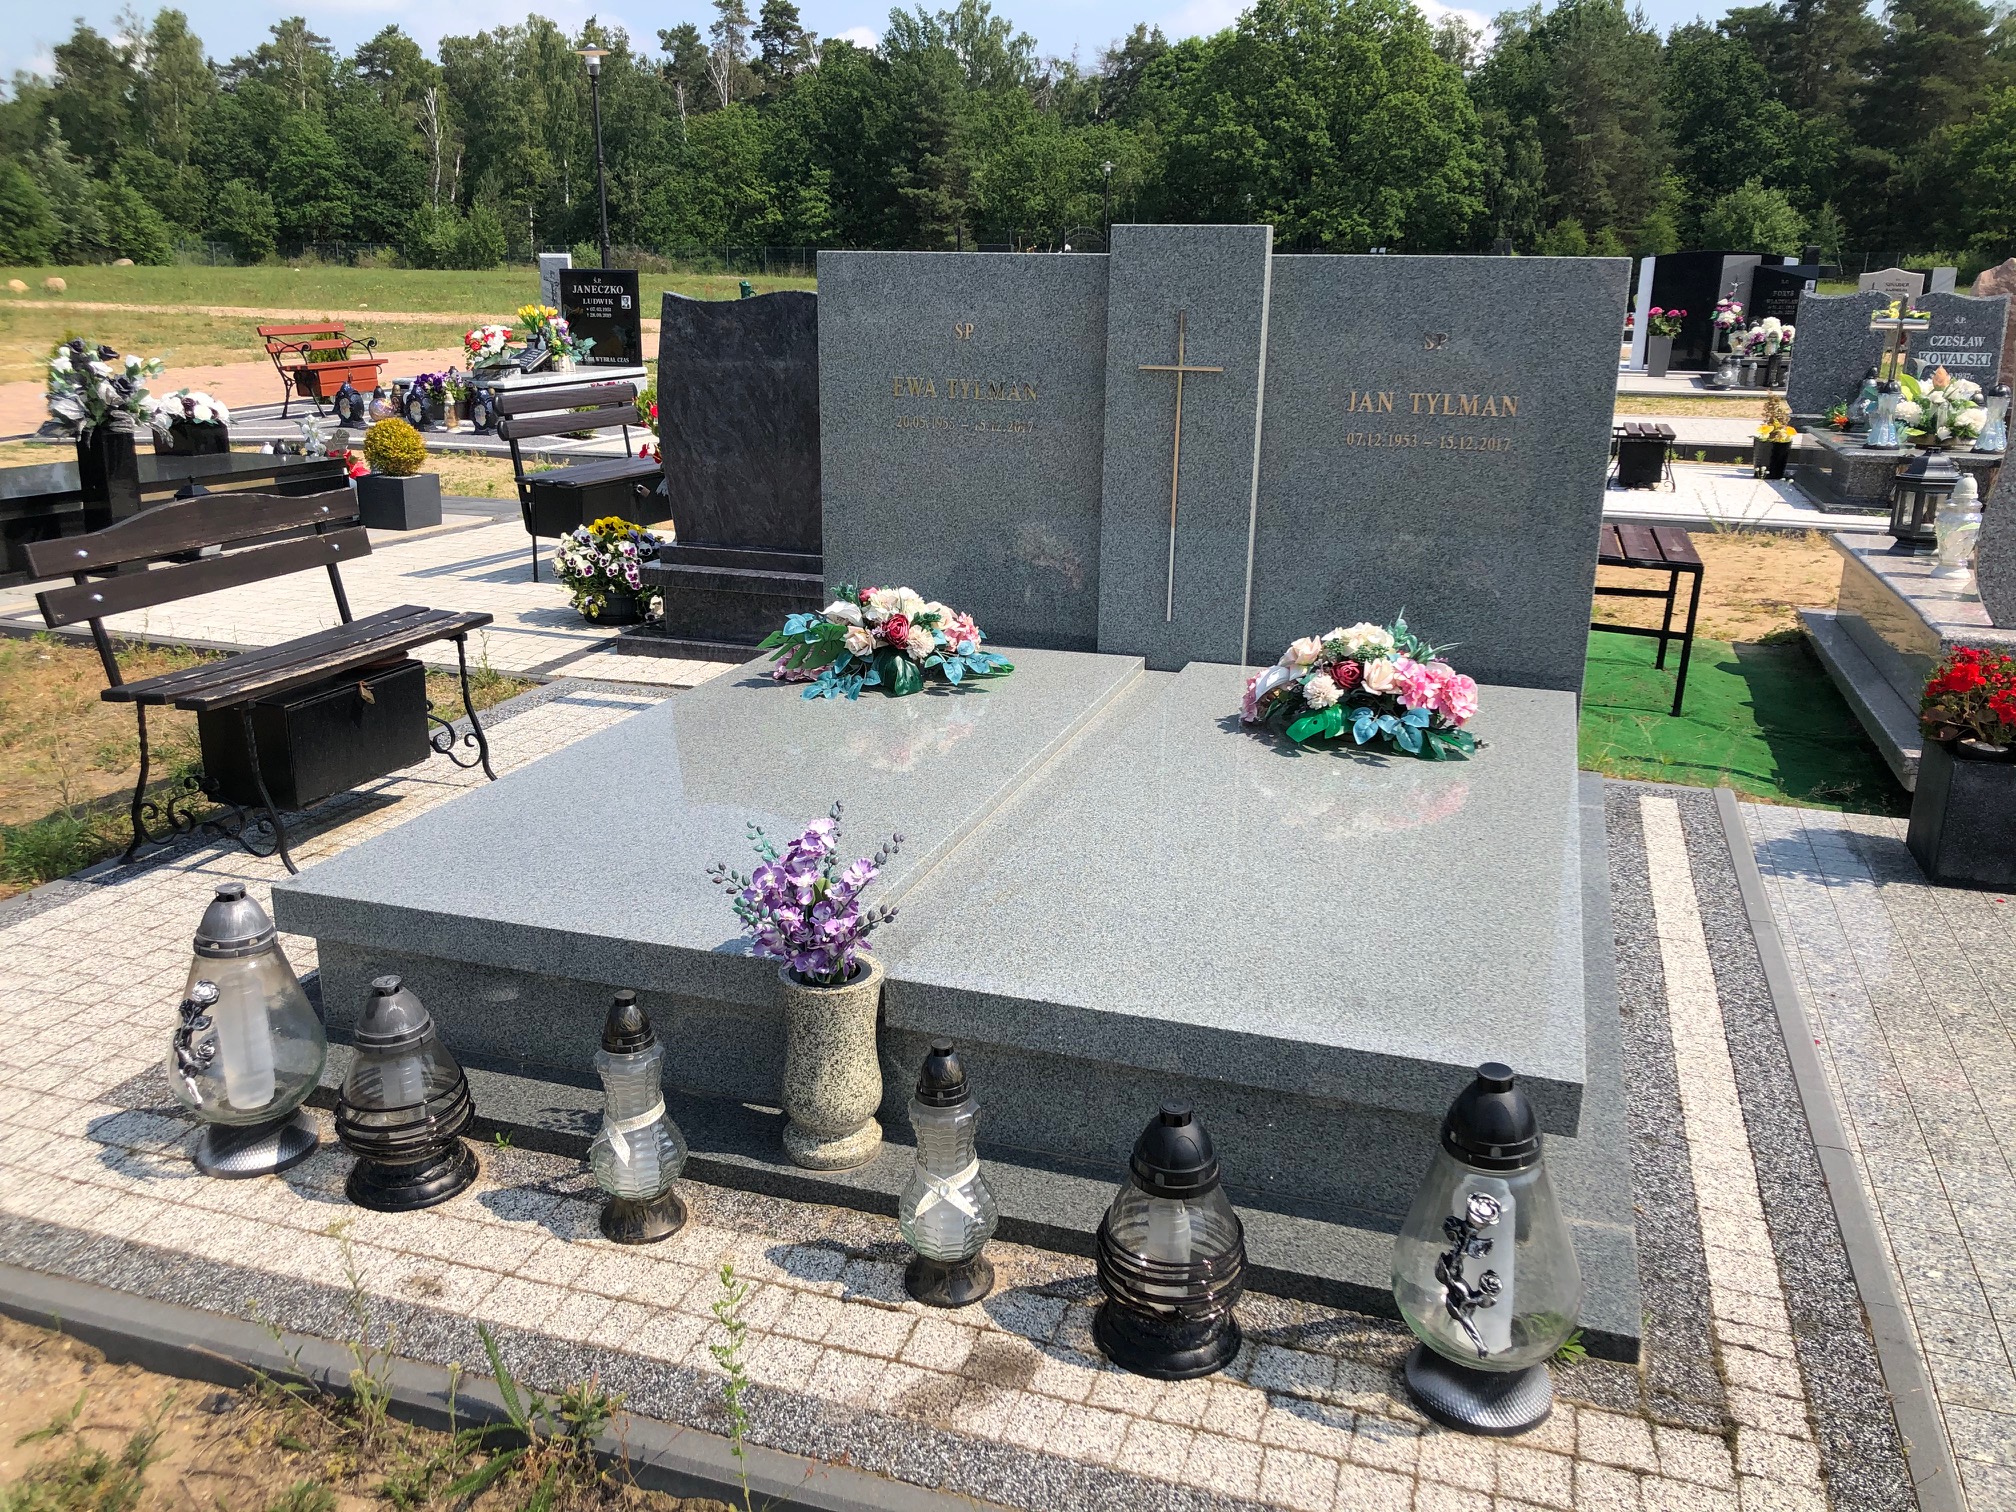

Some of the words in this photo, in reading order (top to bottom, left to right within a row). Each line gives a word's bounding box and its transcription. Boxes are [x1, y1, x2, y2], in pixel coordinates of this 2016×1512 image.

[572, 284, 624, 294] JANECZKO
[1929, 335, 1986, 348] CZESŁAW
[1919, 353, 1992, 366] KOWALSKI
[893, 376, 938, 398] EWA
[946, 378, 1038, 401] TYLMAN
[1347, 391, 1394, 413] JAN
[1409, 392, 1519, 417] TYLMAN
[1346, 432, 1418, 448] 07.12.1953
[1439, 435, 1511, 451] 15.12.2017
